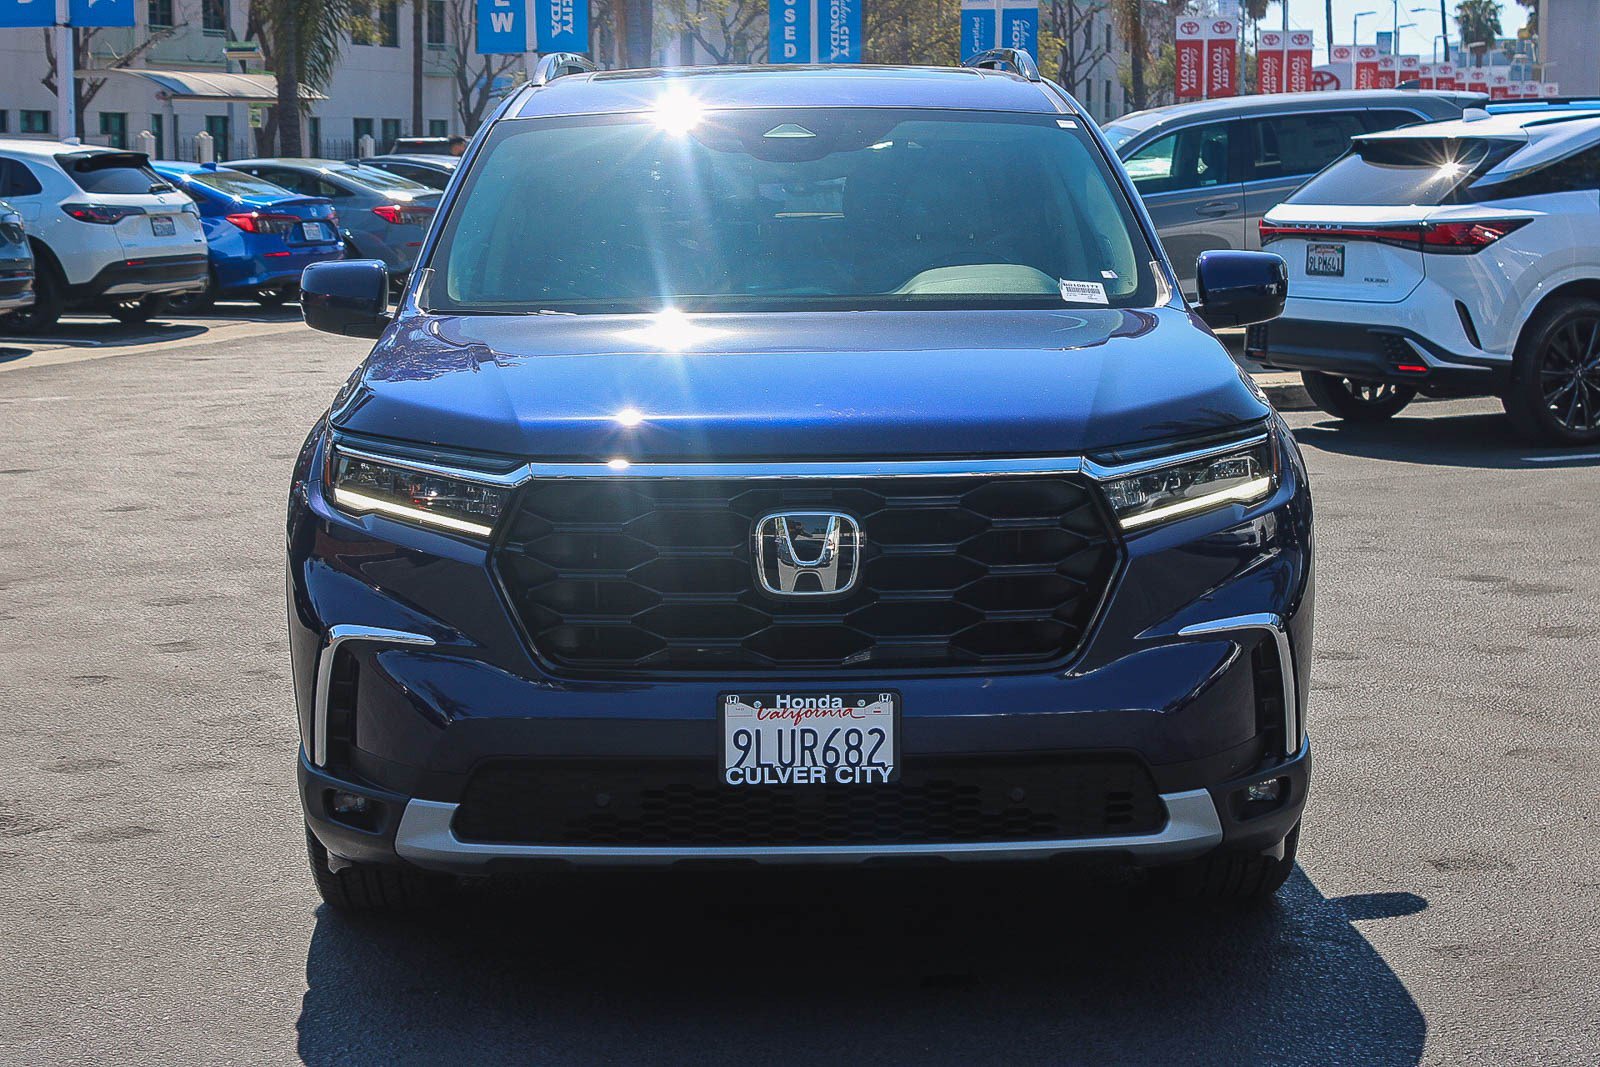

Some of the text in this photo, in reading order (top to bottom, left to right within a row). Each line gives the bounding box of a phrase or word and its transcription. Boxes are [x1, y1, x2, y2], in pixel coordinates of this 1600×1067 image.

[551, 0, 561, 39] DA
[840, 26, 850, 57] CITY
[1180, 46, 1190, 92] TOYOTA
[1212, 46, 1222, 92] TOYOTA
[1222, 69, 1230, 89] CITY
[756, 706, 866, 726] California
[776, 695, 843, 708] Honda
[732, 727, 887, 767] 9LUR682
[725, 766, 894, 785] CULVER CITY
